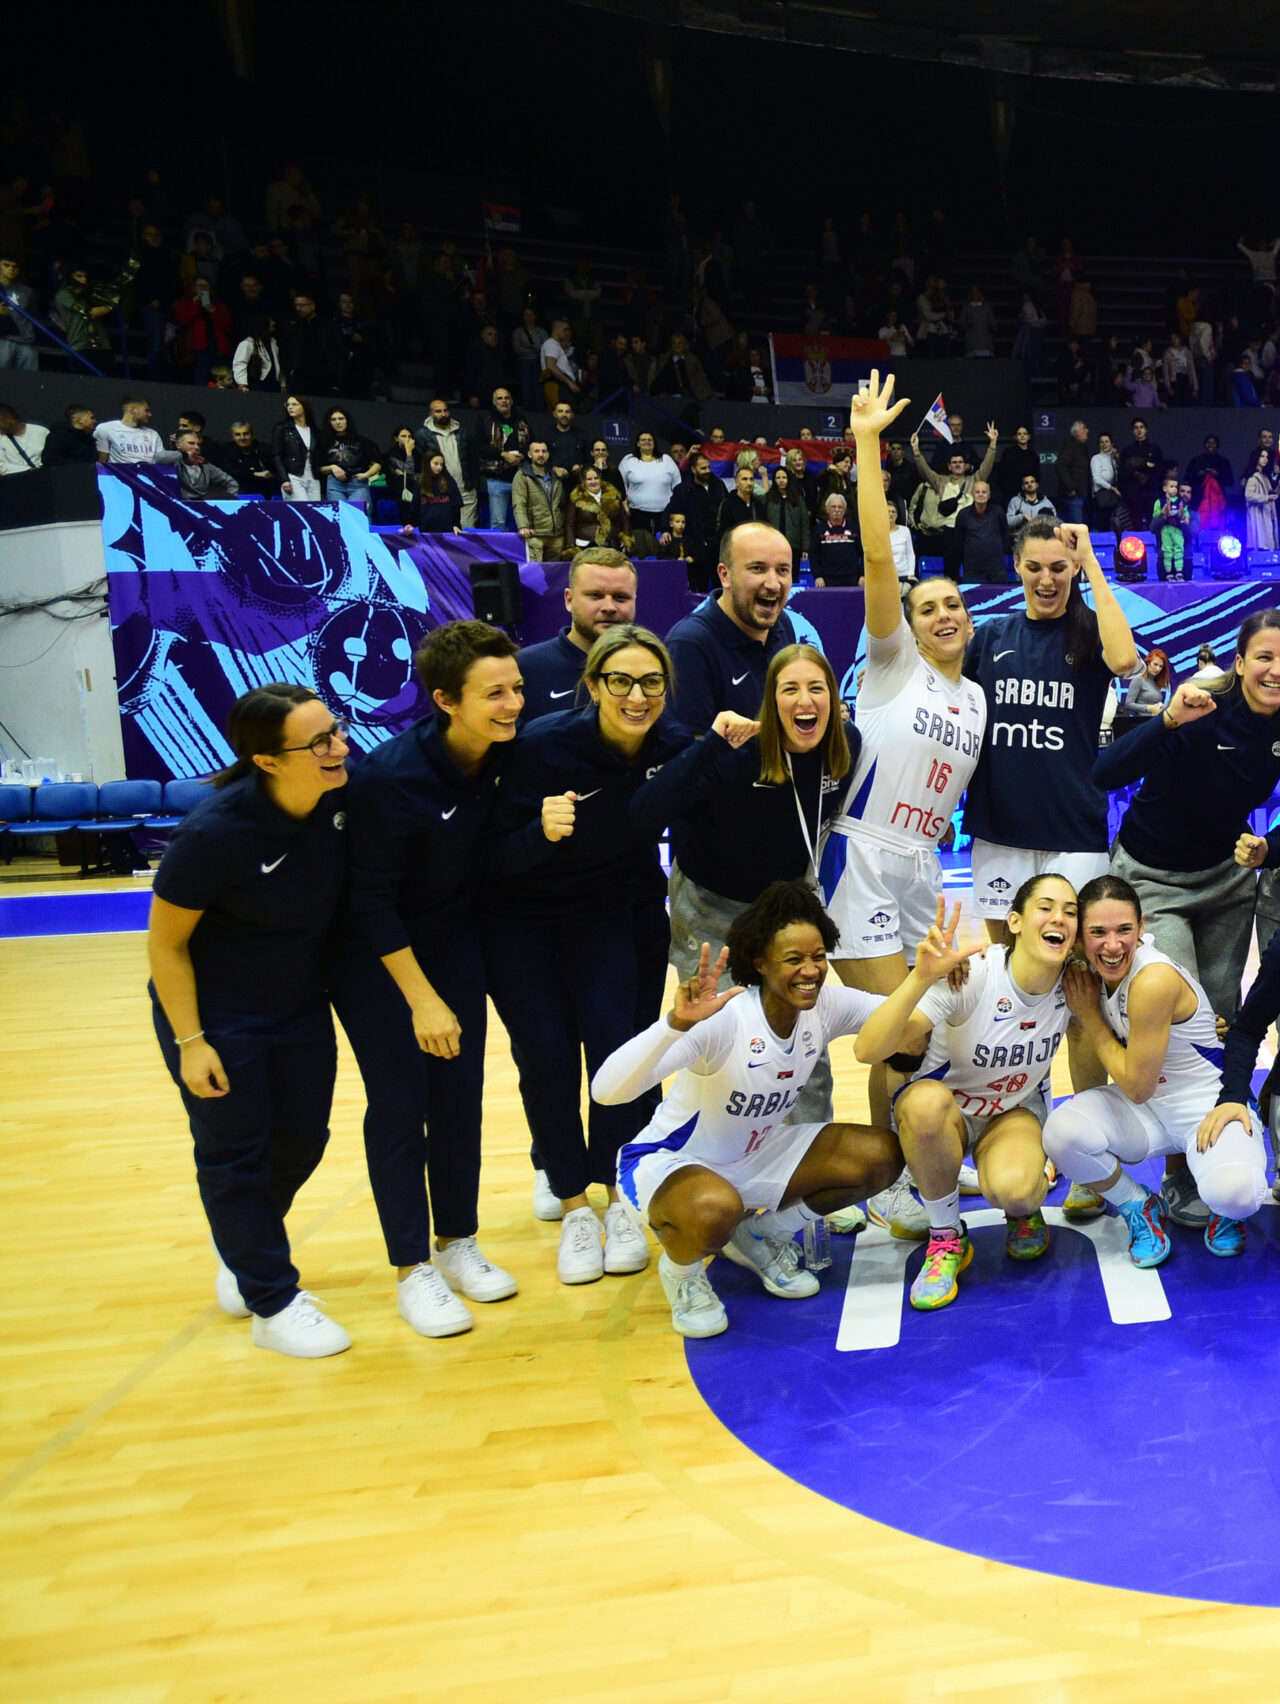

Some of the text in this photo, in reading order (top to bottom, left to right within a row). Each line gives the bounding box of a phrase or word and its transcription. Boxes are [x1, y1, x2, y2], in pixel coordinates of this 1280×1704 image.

[612, 423, 619, 436] 1
[827, 415, 837, 428] 2
[1041, 415, 1049, 426] 3
[995, 677, 1075, 709] SRBIJA
[913, 707, 981, 761] SRBIJA
[991, 718, 1065, 750] mts
[926, 758, 953, 794] 16
[890, 801, 945, 838] mts
[993, 881, 1008, 889] RB
[874, 915, 889, 924] RB
[972, 1031, 1062, 1068] SRBIJA
[725, 1085, 805, 1118] SRBIJ
